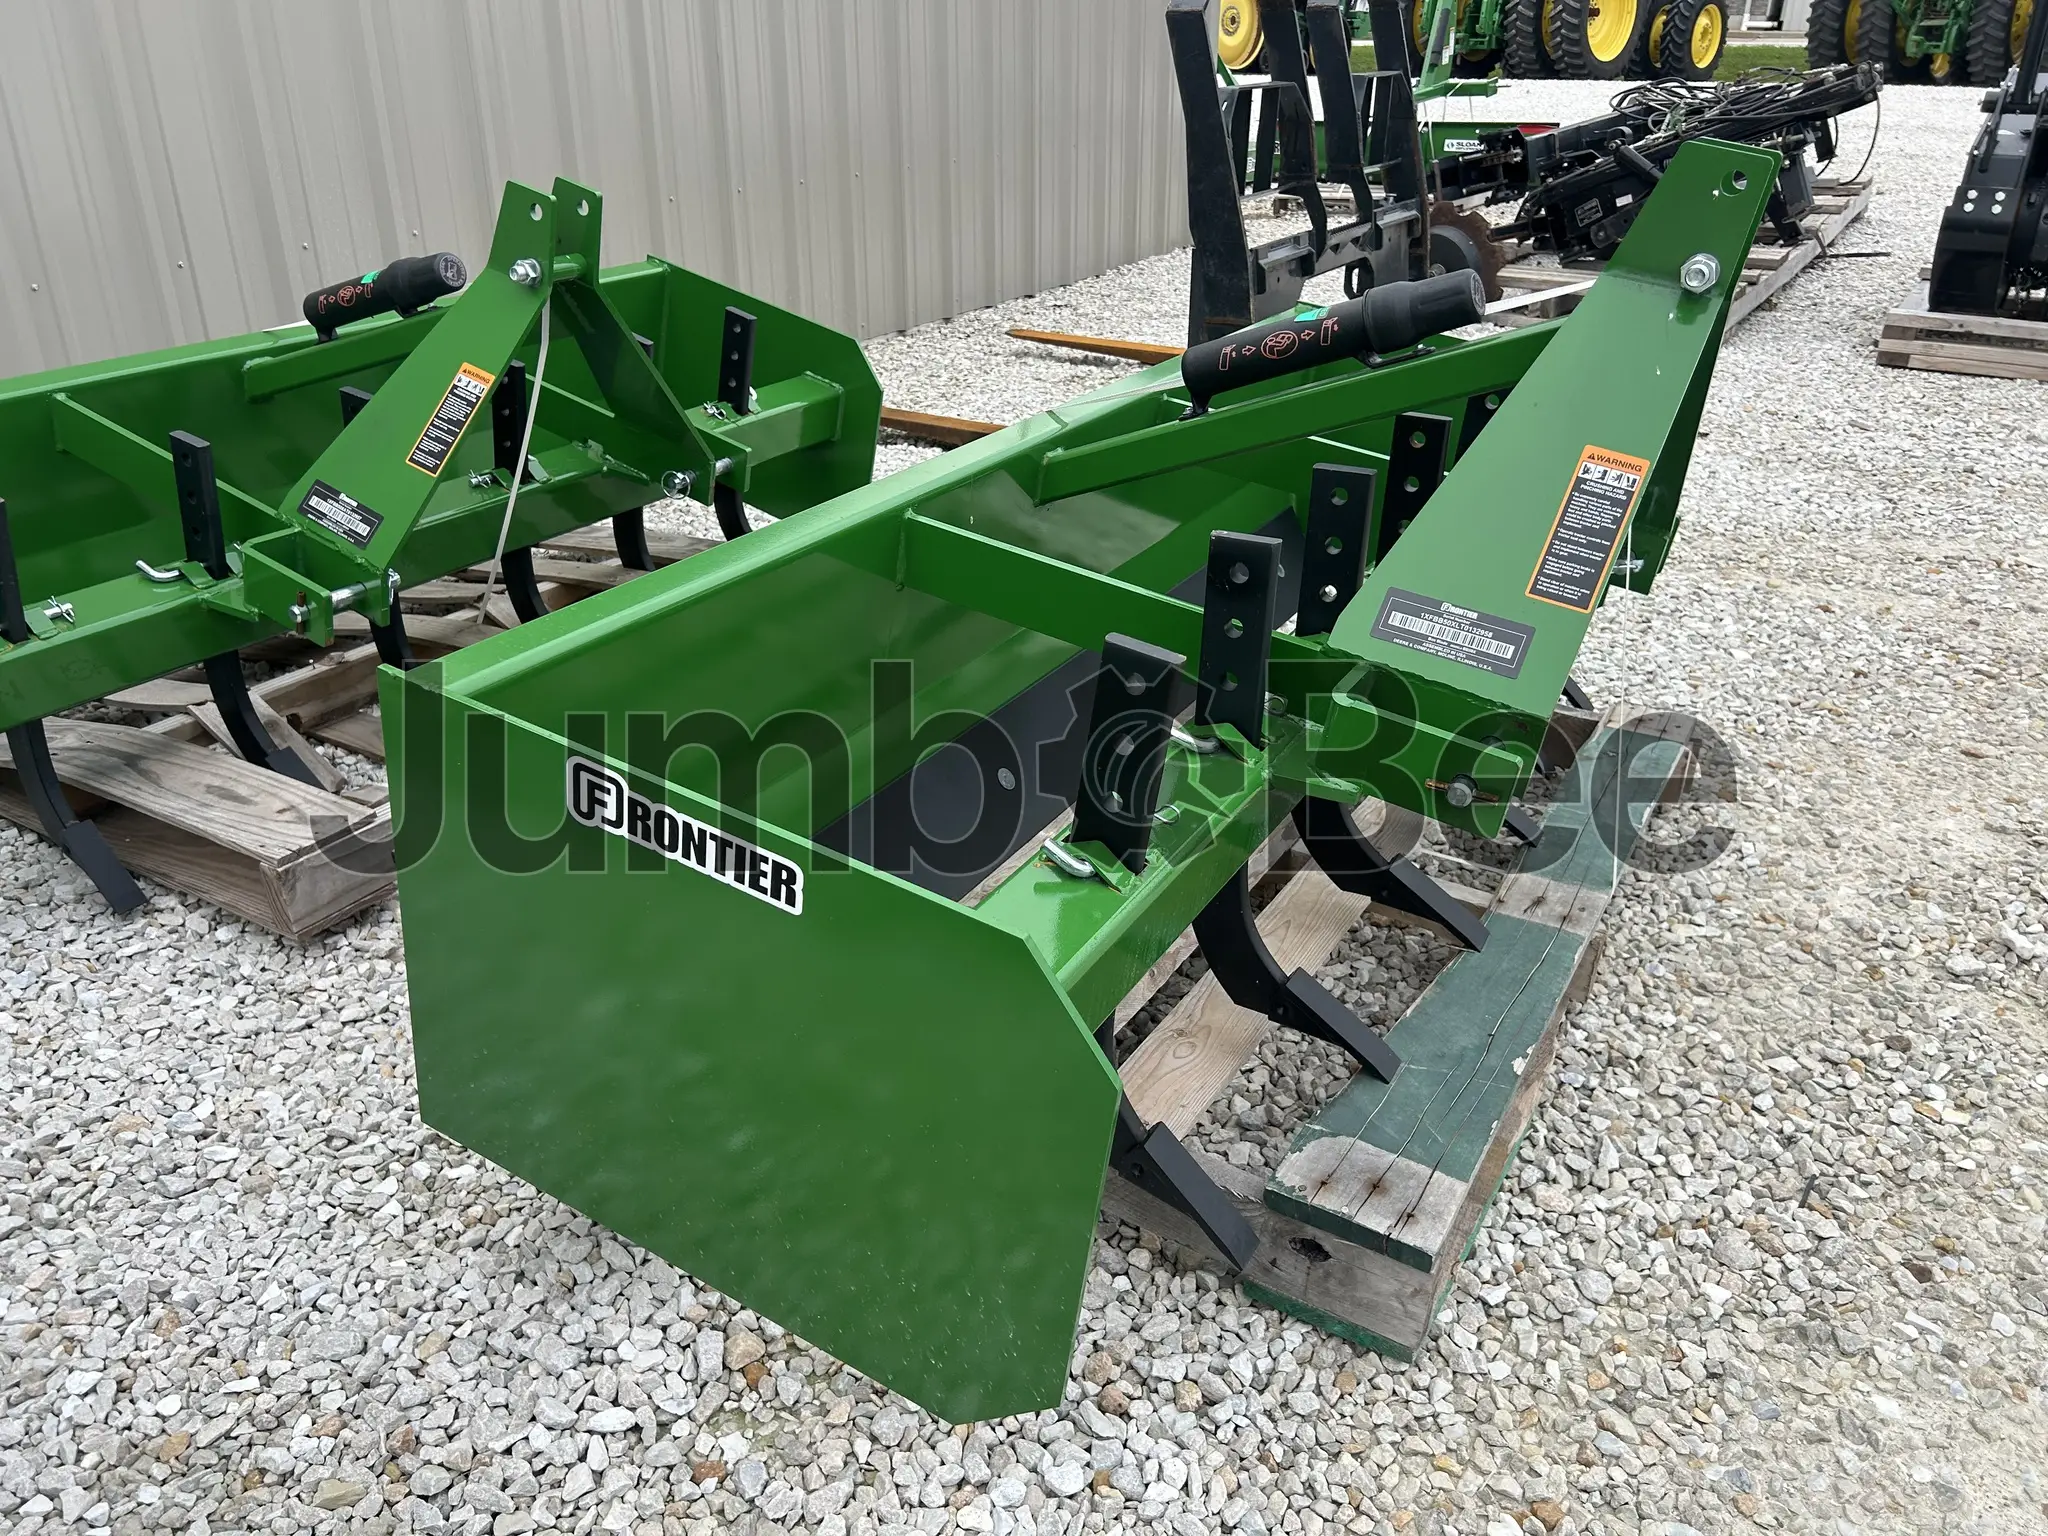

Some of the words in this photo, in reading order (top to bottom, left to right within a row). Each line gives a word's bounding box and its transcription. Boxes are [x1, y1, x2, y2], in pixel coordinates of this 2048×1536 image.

[467, 370, 491, 385] WARNING
[1597, 455, 1642, 471] WARNING
[1580, 484, 1605, 494] PINCHING
[1605, 491, 1627, 500] HAZARD
[1586, 481, 1613, 491] CRUSHING
[1441, 603, 1478, 619] FRONTIER
[570, 758, 801, 911] FRONTIER
